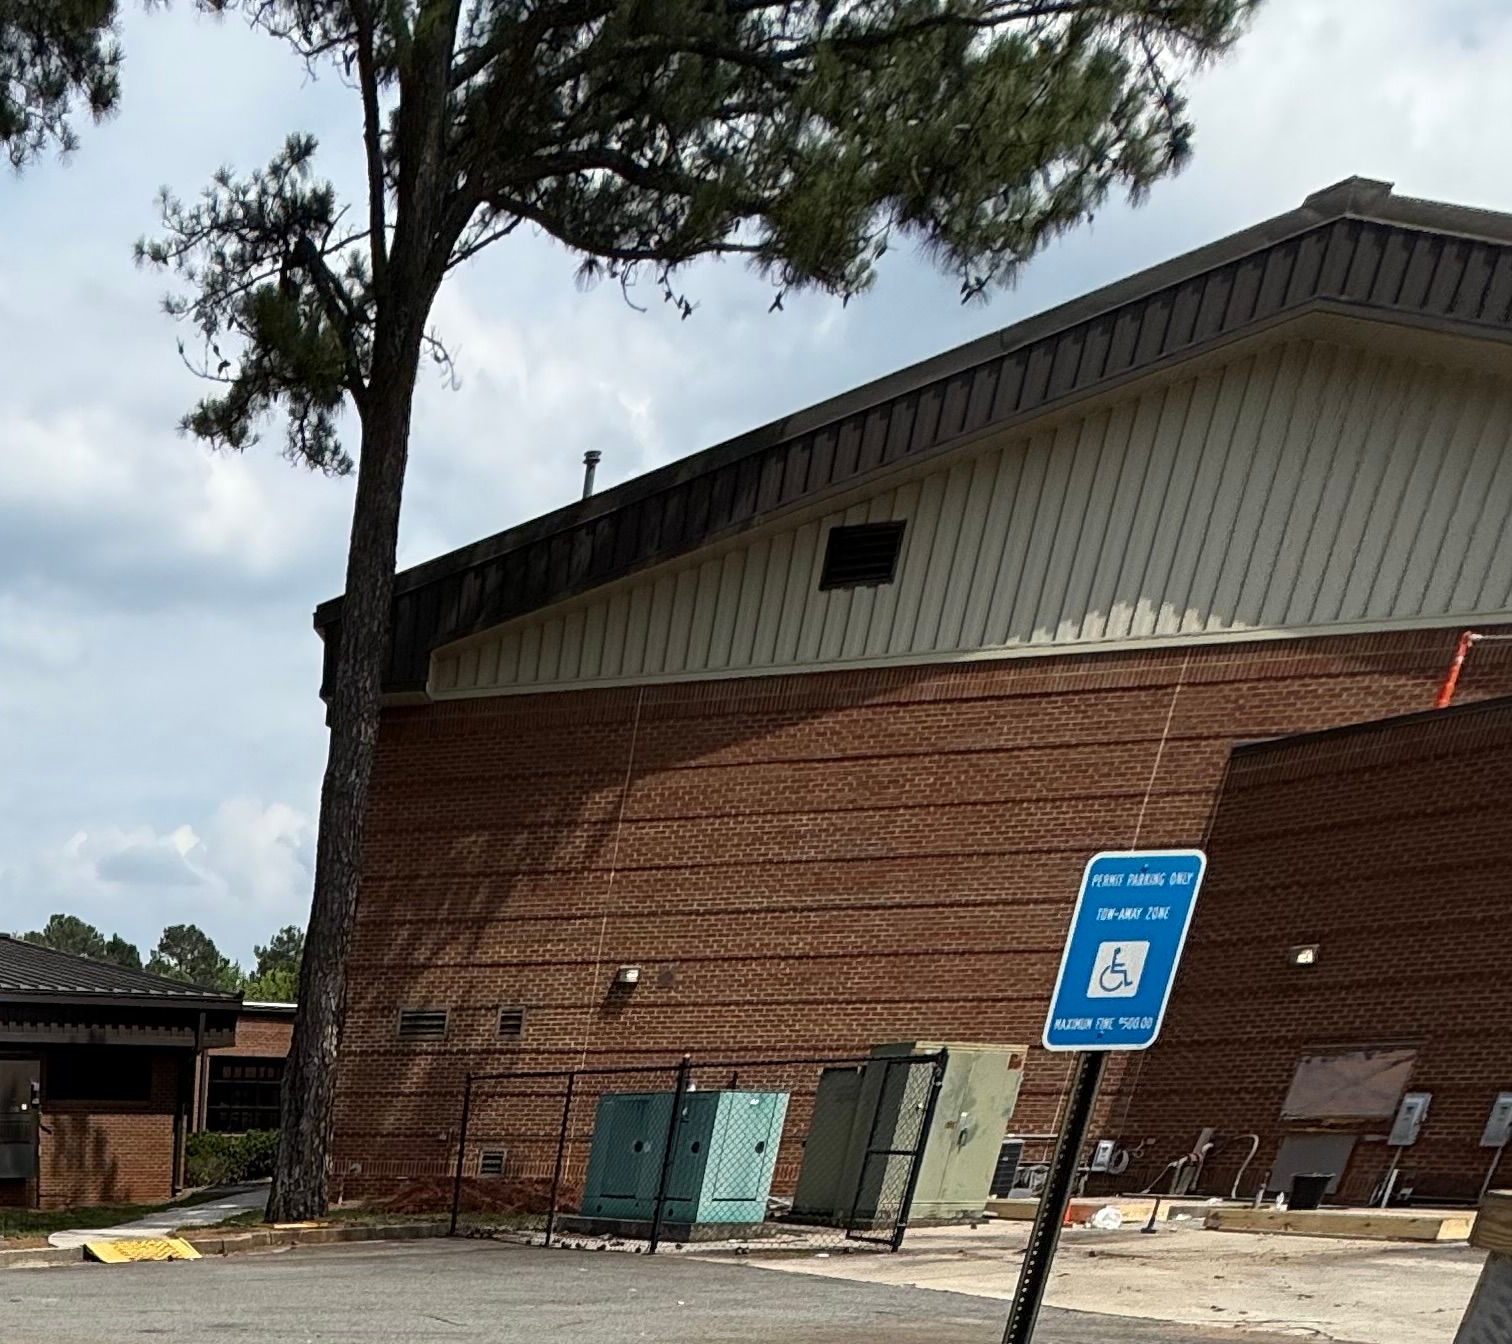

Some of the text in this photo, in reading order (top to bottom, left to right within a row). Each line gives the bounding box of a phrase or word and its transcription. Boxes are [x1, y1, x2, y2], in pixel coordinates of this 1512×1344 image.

[1091, 871, 1194, 888] PERMIT PARKING ONLY
[1095, 905, 1172, 921] TOW-AWAY ZONE
[1053, 1017, 1094, 1031] MAXIMUM
[1094, 1016, 1116, 1031] FINE
